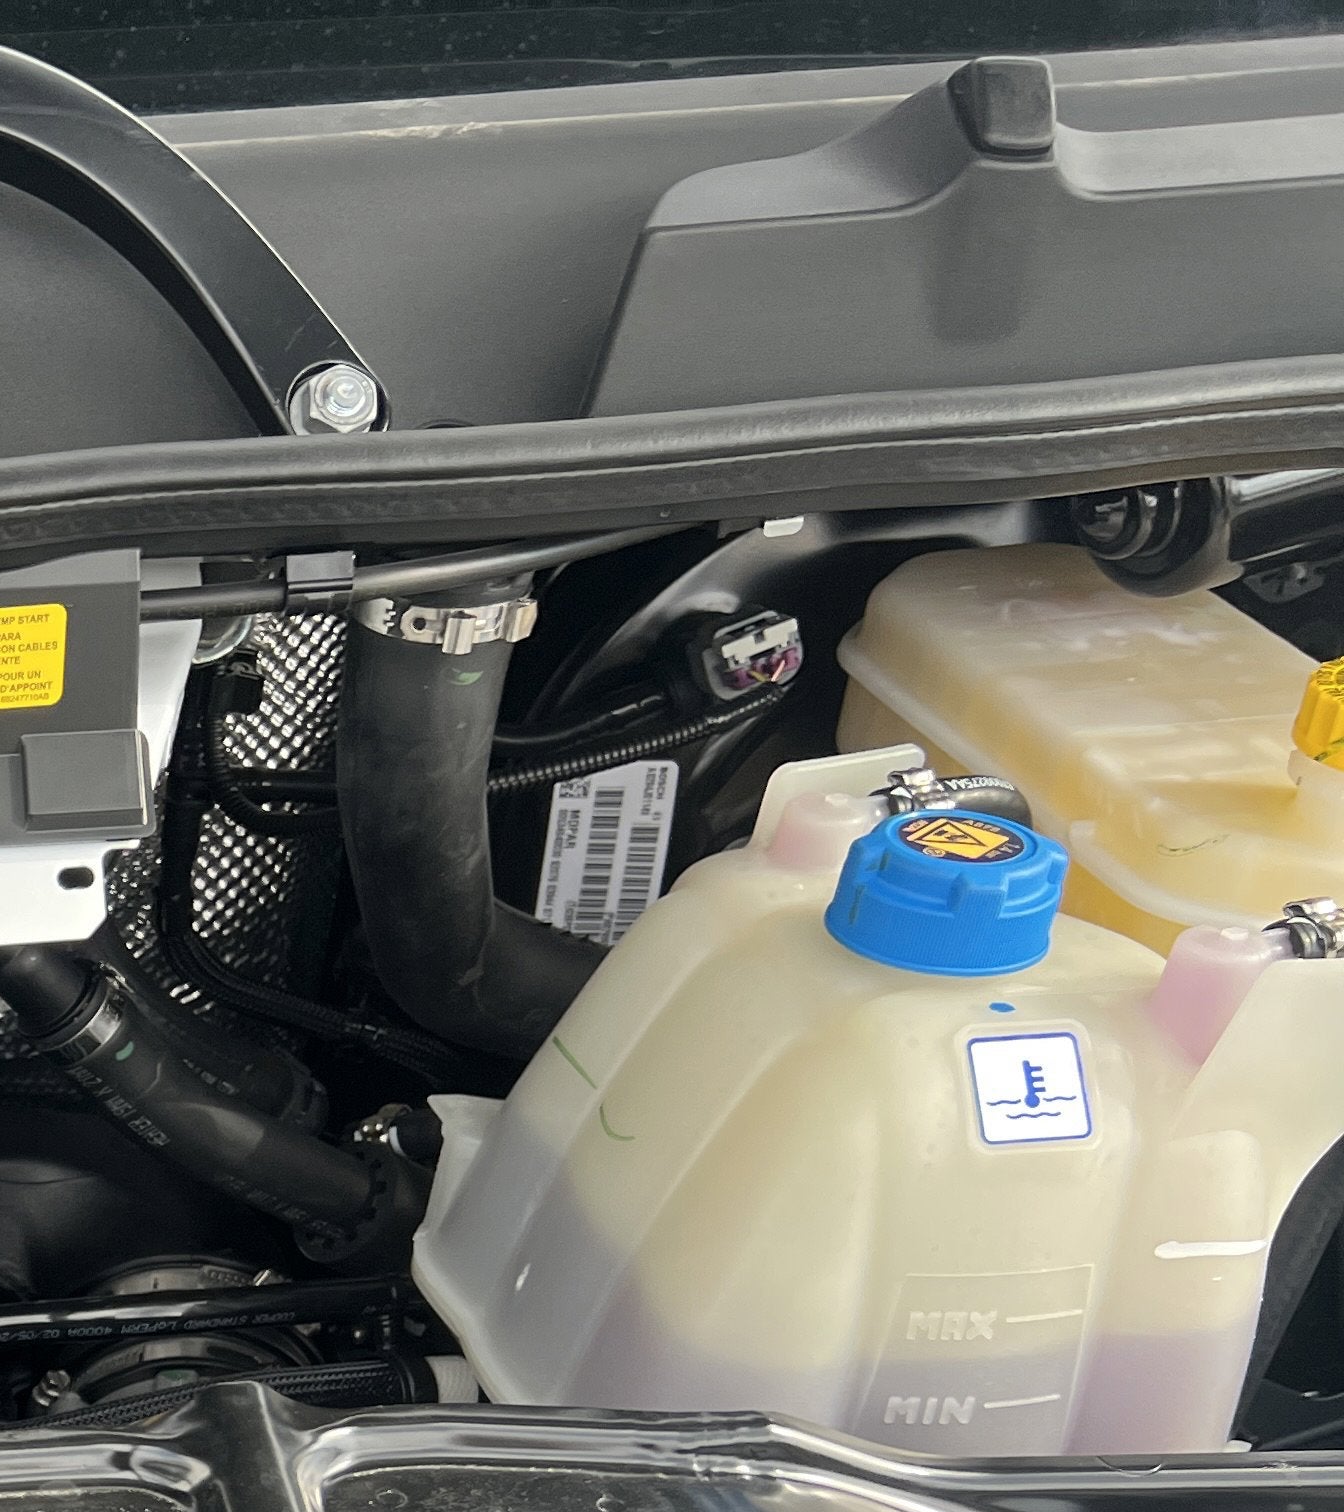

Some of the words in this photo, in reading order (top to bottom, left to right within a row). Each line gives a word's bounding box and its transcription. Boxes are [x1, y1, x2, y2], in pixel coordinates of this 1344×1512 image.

[18, 613, 50, 625] START
[18, 640, 58, 653] CABLES
[27, 669, 42, 679] UN
[0, 681, 53, 694] D'APPOINT
[906, 1309, 998, 1341] MAX
[883, 1395, 976, 1425] MIN
